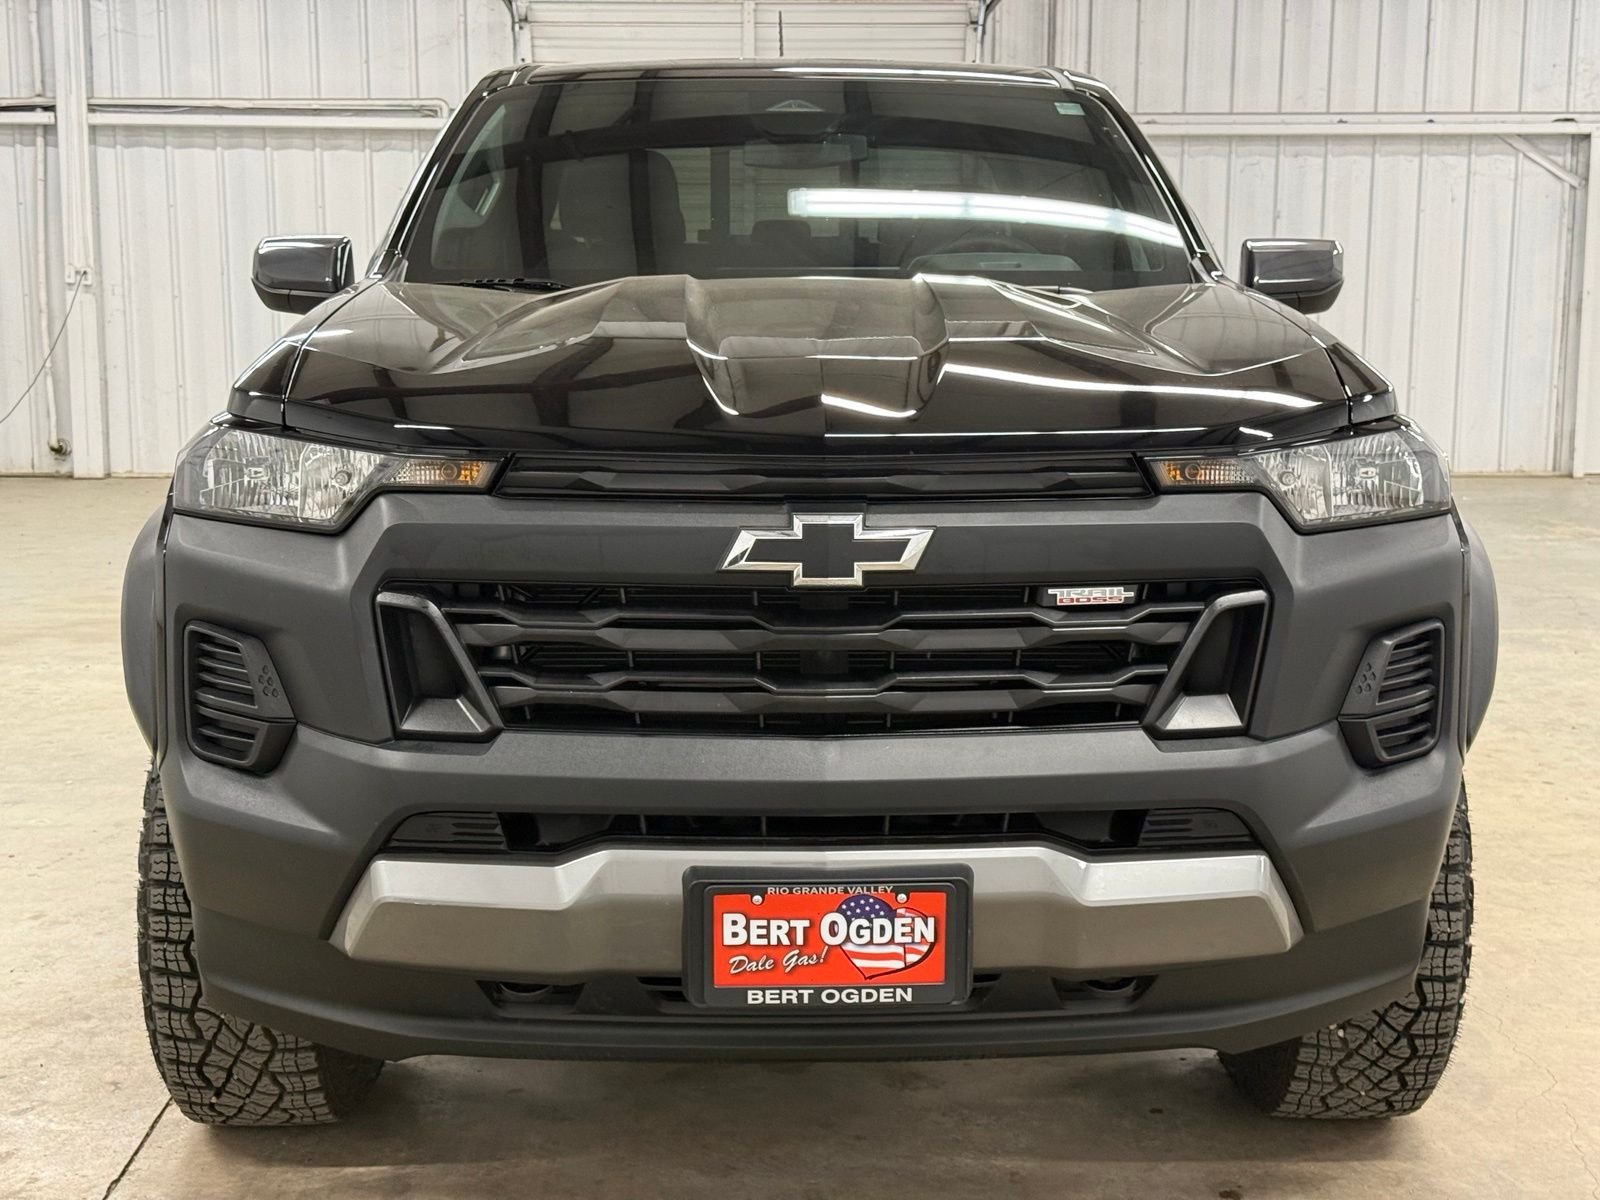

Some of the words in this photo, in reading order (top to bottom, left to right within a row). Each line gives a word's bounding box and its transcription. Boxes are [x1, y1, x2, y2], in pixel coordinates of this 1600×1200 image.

[1048, 587, 1134, 597] TRAIL
[1057, 596, 1124, 605] BOSS
[767, 886, 790, 895] RIO
[793, 886, 846, 895] GRANDE
[848, 885, 894, 895] VALLEY
[722, 912, 811, 946] BERT
[820, 912, 936, 946] OGDEN
[729, 955, 775, 975] Dale
[783, 945, 829, 973] Gas!
[747, 989, 815, 1005] BERT
[821, 987, 913, 1004] OGDEN
